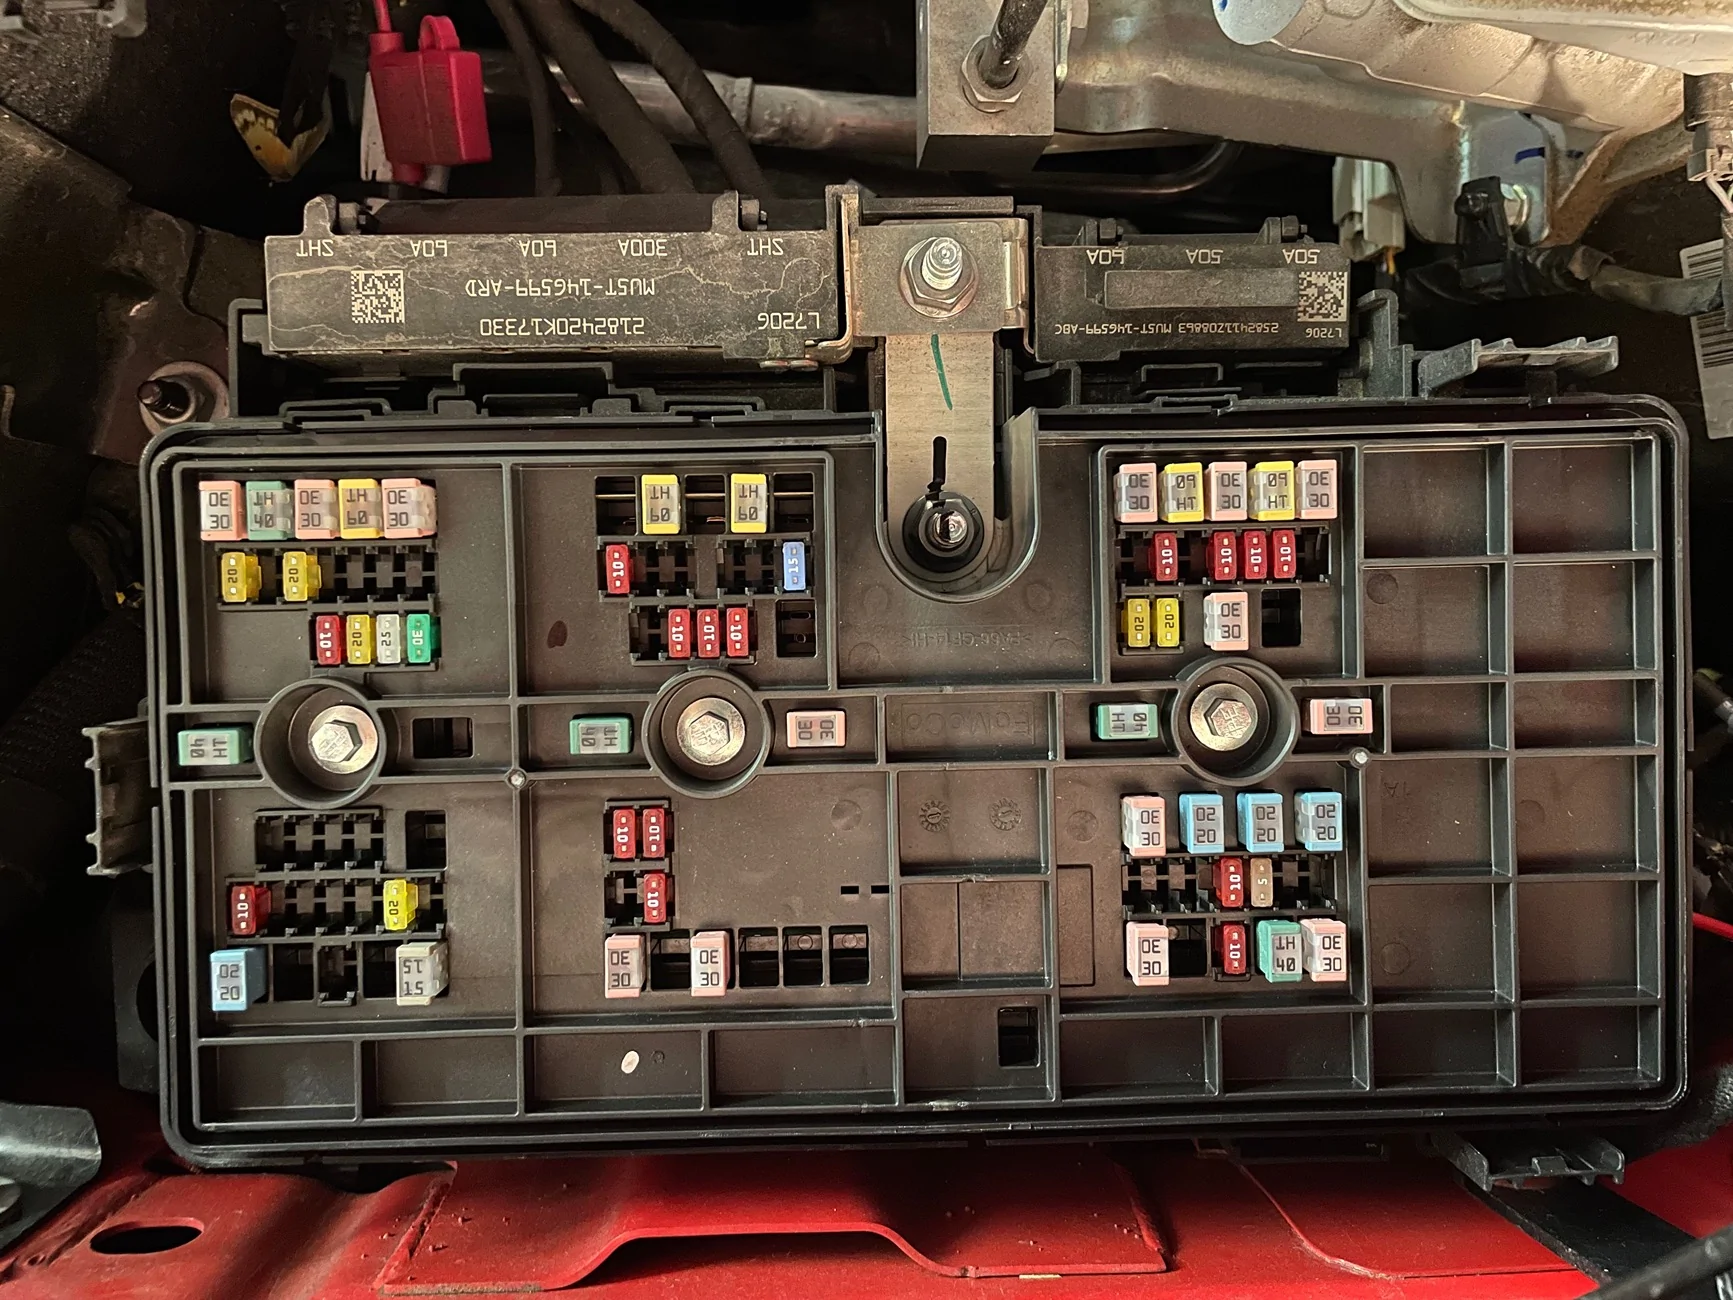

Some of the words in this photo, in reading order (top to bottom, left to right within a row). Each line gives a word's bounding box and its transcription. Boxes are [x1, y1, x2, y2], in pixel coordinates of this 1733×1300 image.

[296, 239, 334, 257] SHT
[409, 239, 448, 257] 60A
[518, 239, 557, 257] 60A
[617, 239, 668, 256] 300A
[746, 238, 784, 255] SHT
[1086, 250, 1125, 264] 60A
[1185, 249, 1224, 264] 50A
[1282, 249, 1321, 264] 50A
[480, 317, 645, 335] 2182420K17330
[1129, 474, 1149, 488] 30
[1176, 475, 1195, 489] 60
[1221, 473, 1241, 487] 30
[1267, 473, 1288, 486] 60
[1309, 471, 1329, 486] 30
[254, 491, 274, 506] HT
[300, 490, 320, 504] 30
[346, 488, 367, 502] HT
[388, 490, 407, 504] 30
[650, 486, 670, 499] HT
[738, 485, 758, 498] HT
[209, 492, 229, 507] 30
[1129, 495, 1150, 510] 30
[1176, 496, 1196, 510] HT
[1221, 495, 1241, 509] 30
[1268, 495, 1287, 508] HT
[1309, 493, 1329, 507] 30
[301, 512, 321, 527] 30
[347, 510, 368, 525] 60
[389, 512, 409, 526] 30
[650, 508, 670, 522] 60
[738, 506, 758, 520] 60
[210, 514, 230, 529] 30
[254, 514, 274, 528] 40
[1162, 549, 1173, 564] 10
[1221, 548, 1232, 563] 10
[1250, 548, 1261, 563] 10
[1280, 547, 1291, 562] 10
[612, 562, 624, 577] 10
[788, 558, 798, 573] 15
[227, 568, 238, 584] 20
[289, 568, 299, 584] 20
[1221, 603, 1241, 617] 30
[1134, 617, 1144, 631] 20
[1165, 614, 1174, 629] 20
[352, 632, 362, 647] 20
[381, 632, 392, 646] 25
[412, 630, 424, 646] 30
[672, 625, 684, 642] 10
[703, 625, 715, 640] 10
[730, 624, 742, 640] 10
[1221, 625, 1241, 639] 30
[319, 632, 332, 648] 10
[1326, 706, 1341, 726] 30
[1348, 706, 1363, 725] 30
[798, 721, 812, 740] 30
[820, 720, 834, 740] 30
[1133, 714, 1147, 733] 40
[582, 727, 596, 747] 40
[190, 738, 205, 759] 40
[1141, 810, 1160, 824] 30
[1196, 807, 1216, 822] 20
[1256, 806, 1276, 821] 20
[1316, 804, 1336, 819] 20
[617, 827, 628, 843] 10
[649, 826, 660, 841] 10
[1141, 832, 1160, 846] 30
[1197, 829, 1216, 843] 20
[1256, 828, 1276, 842] 20
[1317, 826, 1337, 840] 20
[1229, 874, 1241, 890] 10
[389, 900, 399, 915] 20
[647, 892, 660, 908] 10
[237, 902, 249, 919] 10
[1142, 939, 1161, 953] 30
[1276, 936, 1295, 950] HT
[1322, 936, 1341, 950] 30
[610, 951, 630, 965] 30
[699, 950, 719, 964] 30
[1229, 943, 1241, 959] 10
[220, 964, 240, 978] 20
[403, 959, 423, 974] 15
[1142, 961, 1161, 975] 30
[1276, 957, 1296, 972] 40
[1322, 958, 1342, 972] 30
[611, 973, 631, 987] 30
[700, 972, 720, 986] 30
[220, 986, 240, 1000] 20
[404, 981, 423, 995] 15
